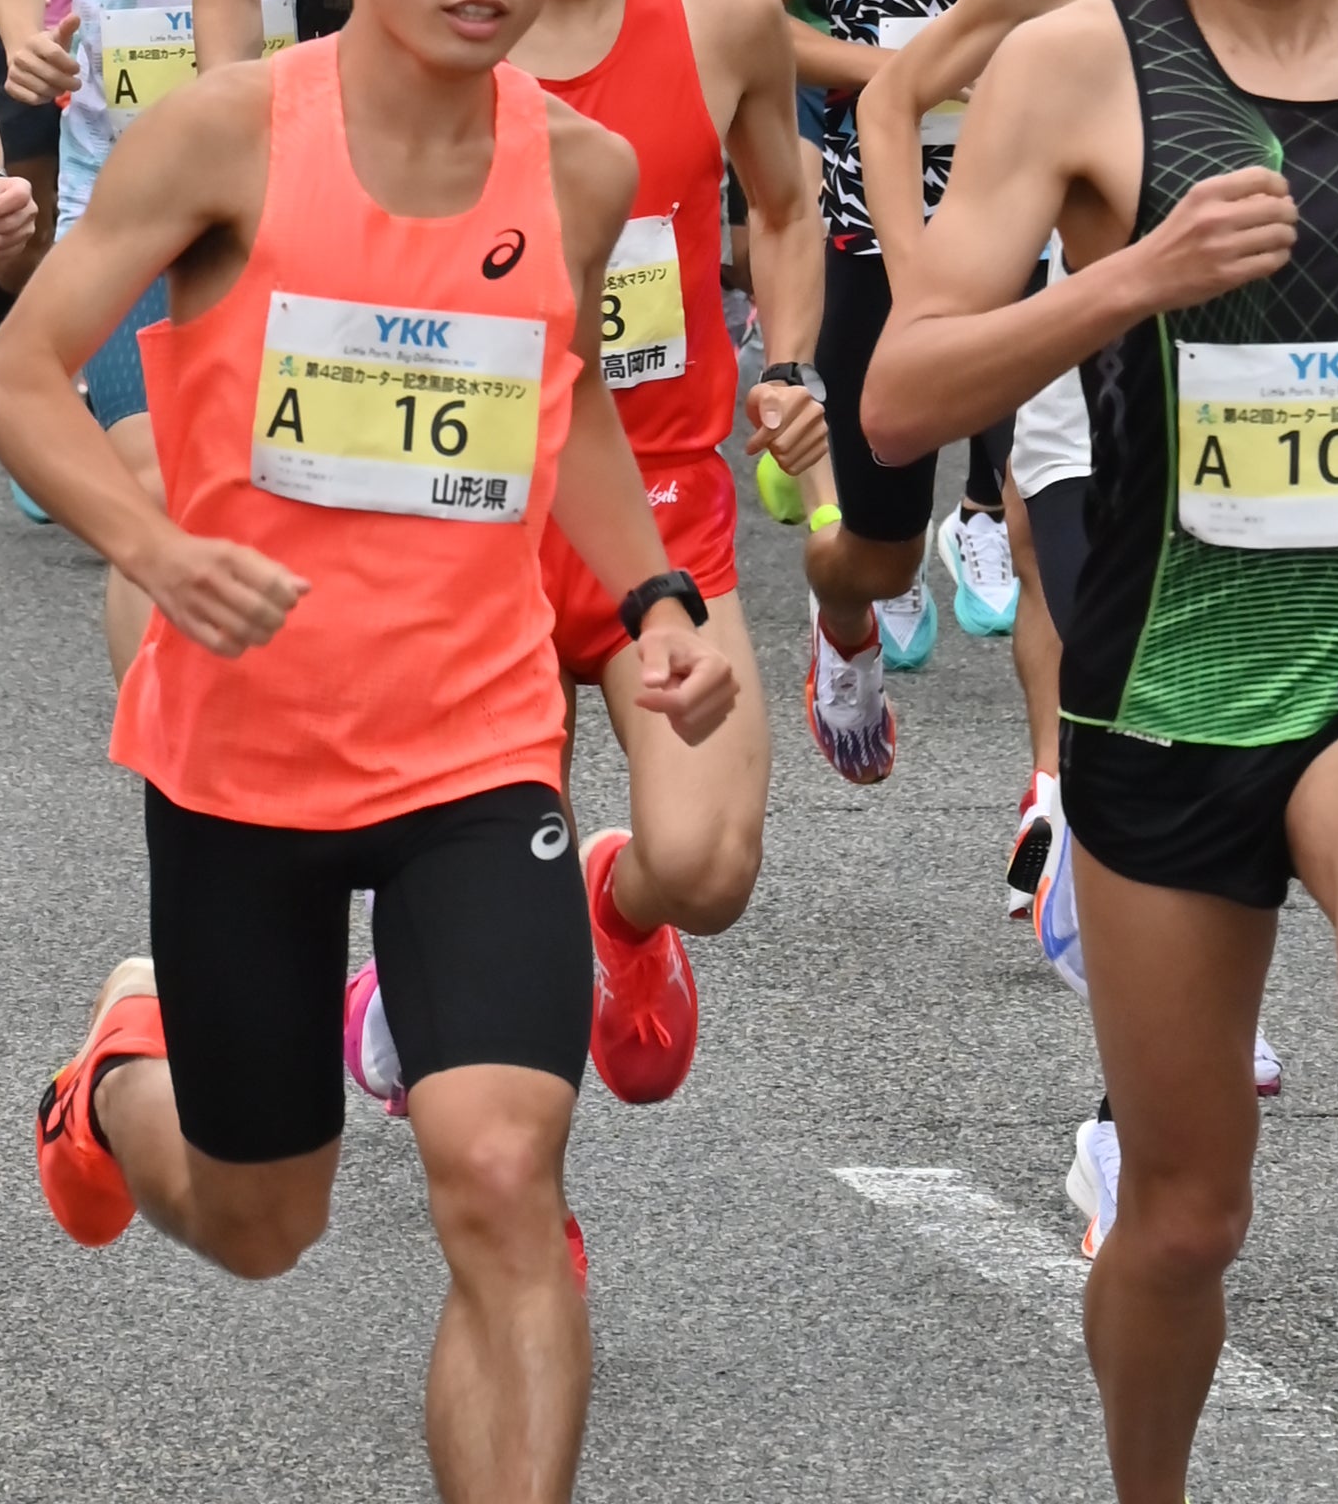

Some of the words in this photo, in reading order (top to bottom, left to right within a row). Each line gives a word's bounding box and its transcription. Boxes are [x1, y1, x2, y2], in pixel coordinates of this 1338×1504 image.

[115, 68, 139, 105] A
[374, 313, 451, 349] YKK
[304, 360, 528, 400] 第42回カーター記念黒部名水マラソン
[601, 345, 668, 381] 高岡市
[265, 386, 305, 445] A
[394, 394, 470, 458] 16
[1193, 434, 1232, 489] A
[431, 472, 509, 511] 山形県
